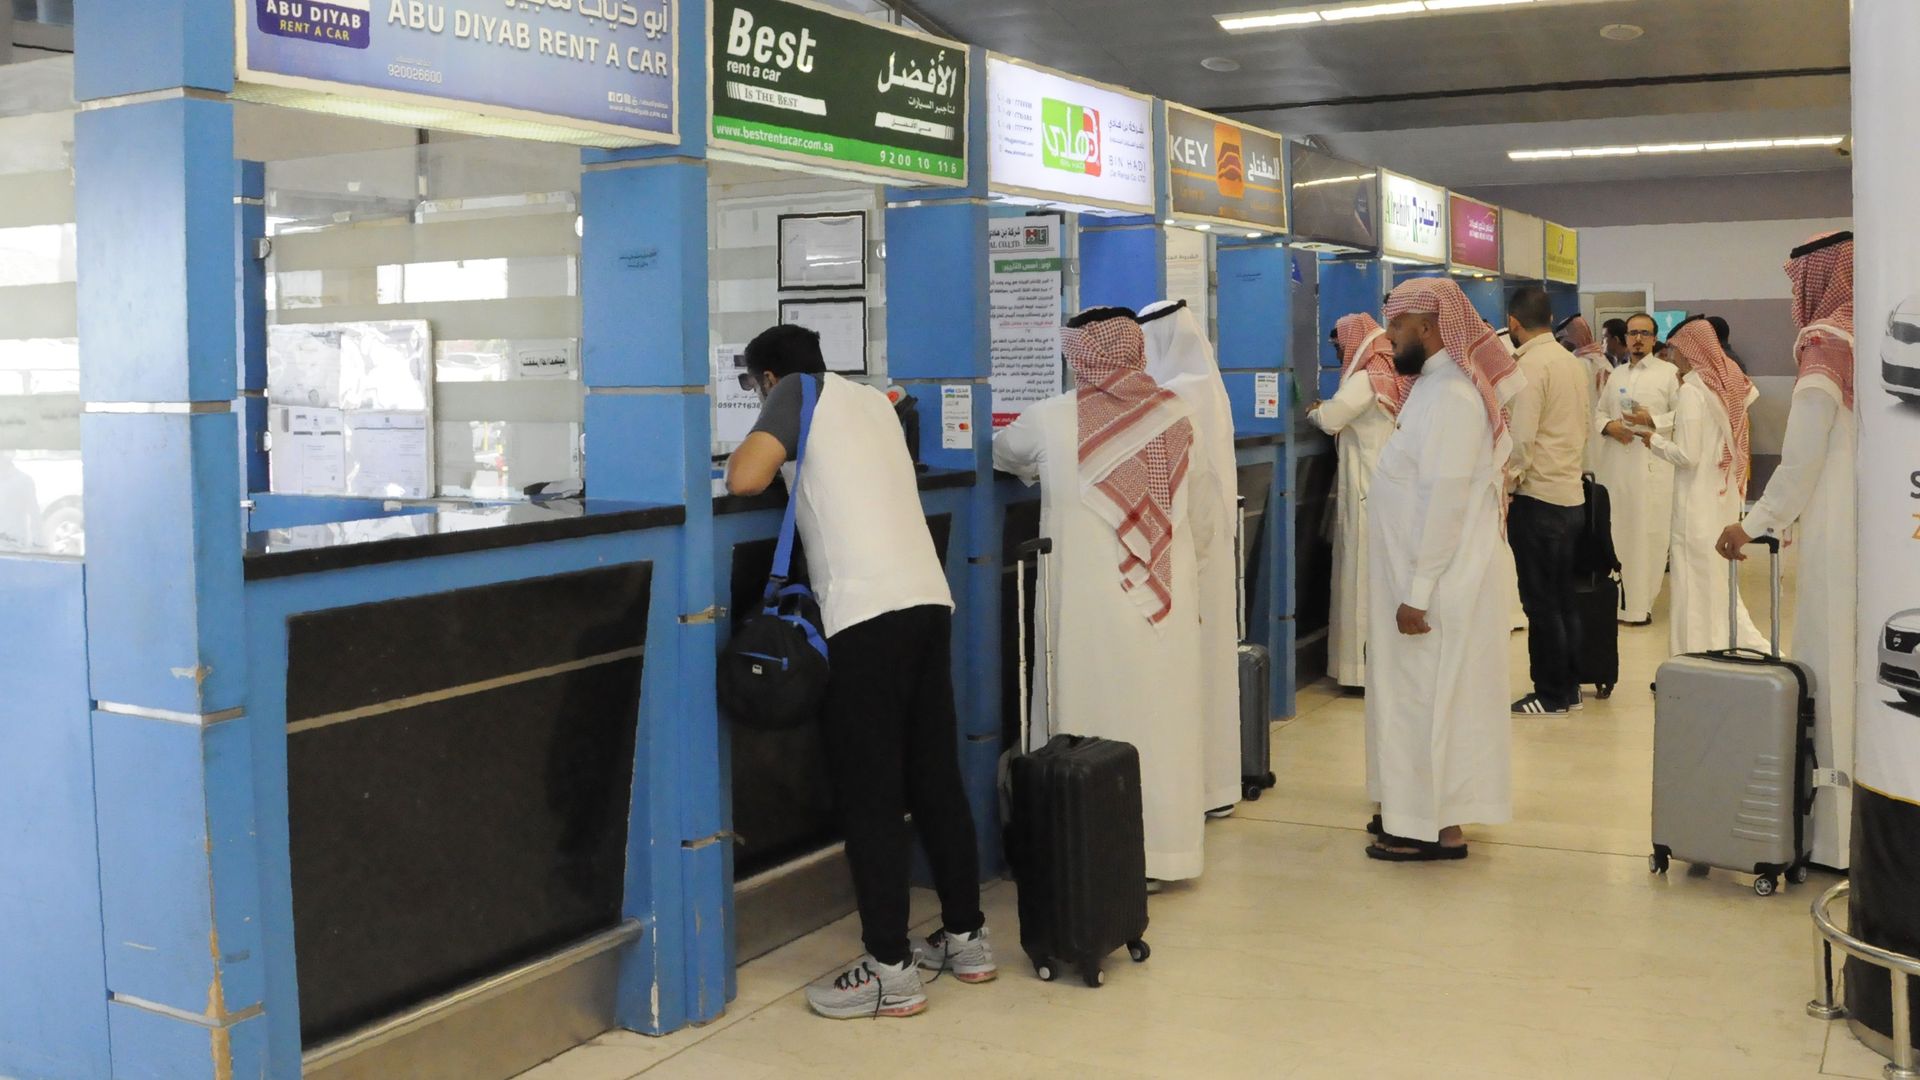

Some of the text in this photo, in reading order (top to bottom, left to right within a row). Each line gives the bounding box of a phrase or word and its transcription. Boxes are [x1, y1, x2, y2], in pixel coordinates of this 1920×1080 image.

[266, 0, 362, 29] ABU DIYAB
[279, 20, 350, 41] RENT A CAR
[387, 0, 668, 77] ABU DIYAB RENT A CAR
[726, 7, 817, 74] Best
[726, 60, 782, 83] rent a car
[876, 49, 957, 99] الأفضل
[907, 96, 934, 110] السيارات
[716, 123, 834, 153] www.bestrentacar.com.sa
[1169, 134, 1208, 168] KEY
[1109, 155, 1146, 172] BIN HADI
[1247, 151, 1281, 182] المفتاح
